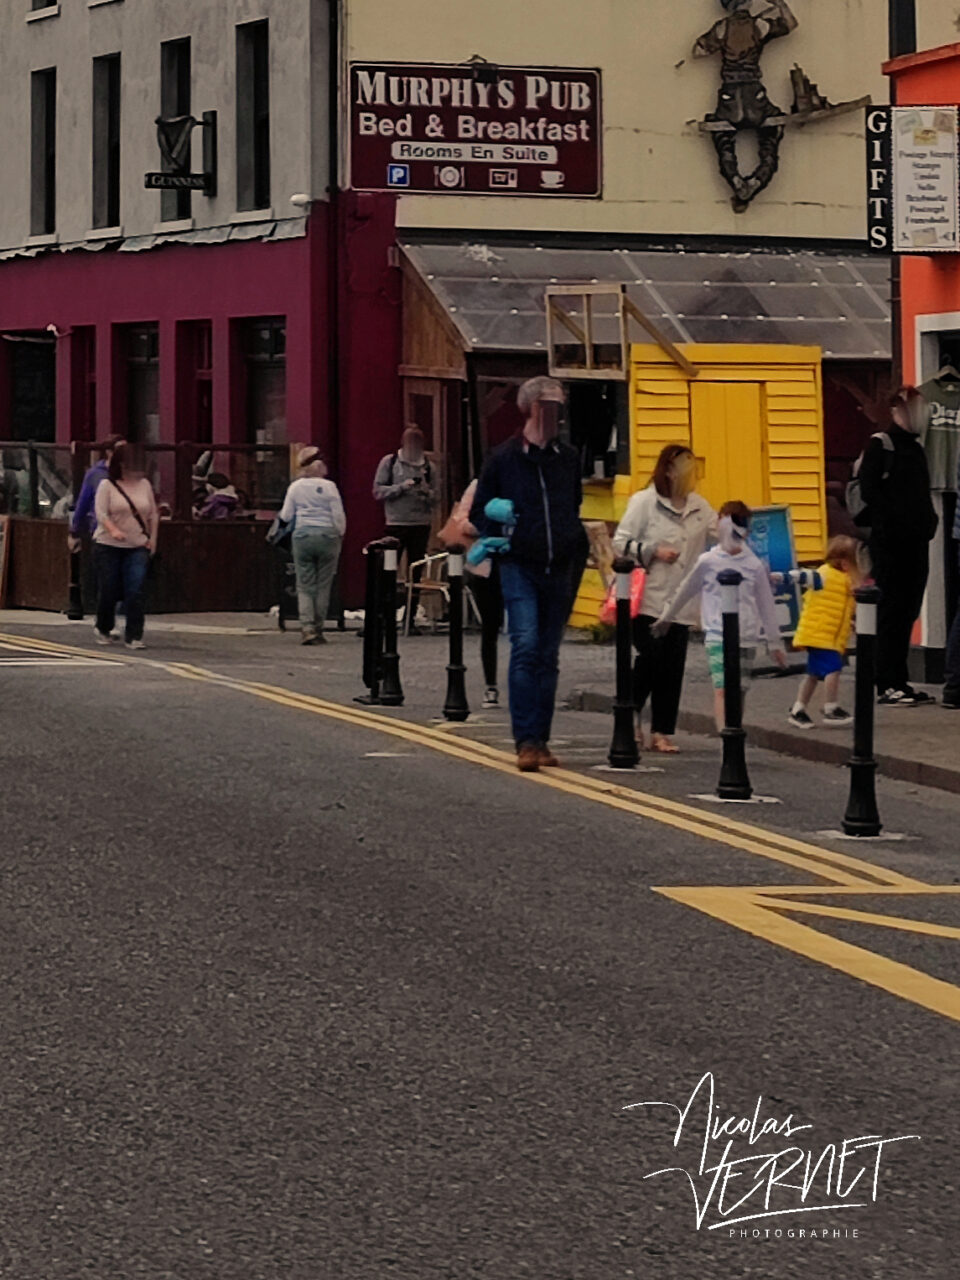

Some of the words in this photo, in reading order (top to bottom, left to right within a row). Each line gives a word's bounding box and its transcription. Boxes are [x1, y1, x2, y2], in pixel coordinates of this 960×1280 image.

[525, 75, 592, 111] PUB
[359, 112, 413, 137] Bed
[425, 114, 444, 139] &
[457, 114, 591, 142] Breakfast
[400, 144, 463, 158] Rooms
[471, 146, 494, 159] En
[502, 147, 549, 161] Suite
[867, 110, 888, 249] GIFTS
